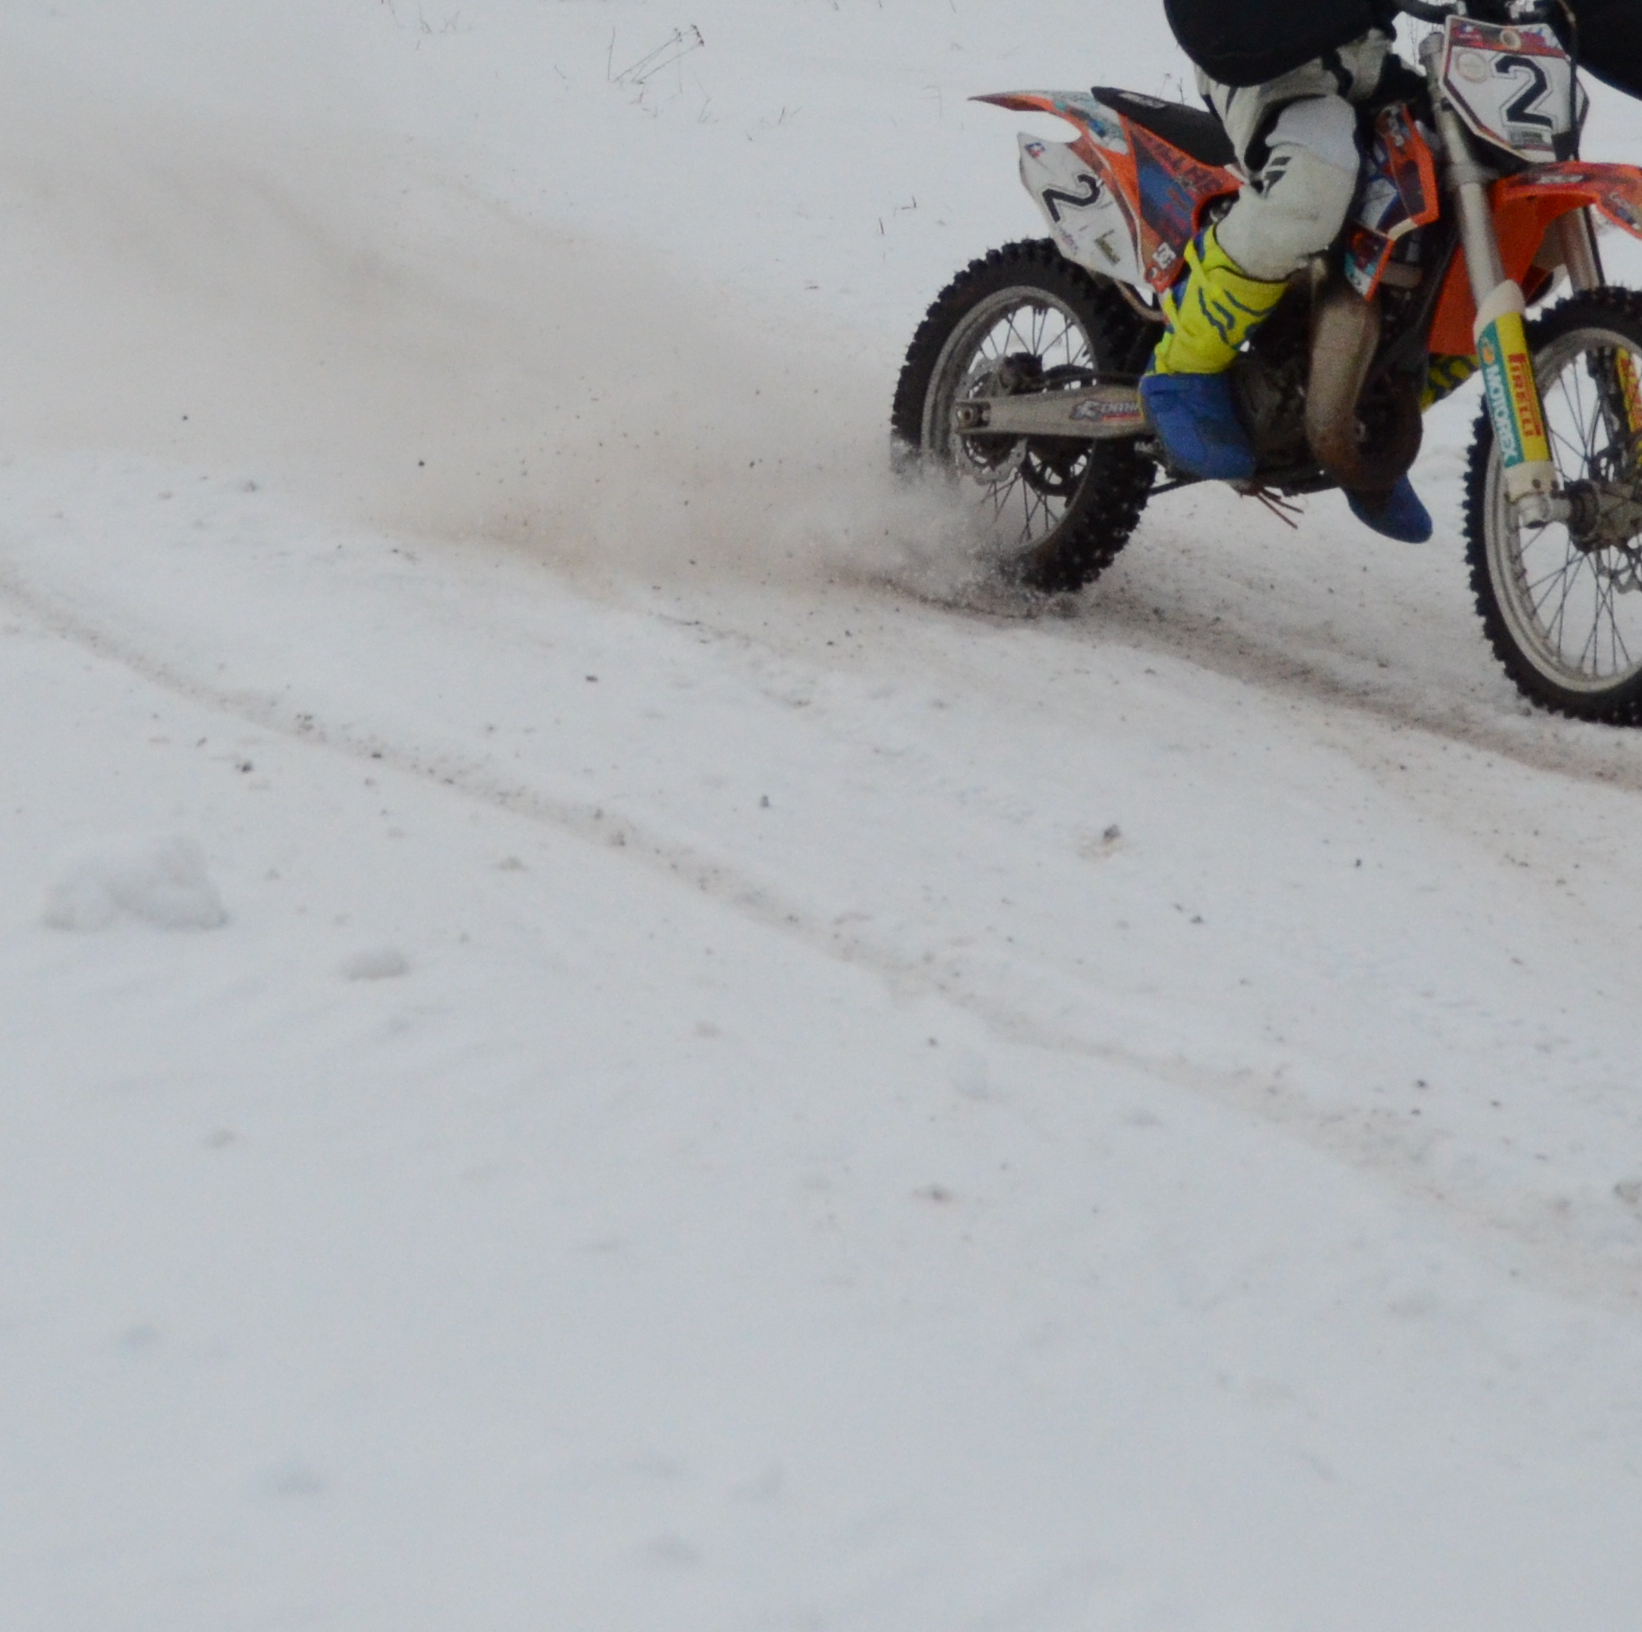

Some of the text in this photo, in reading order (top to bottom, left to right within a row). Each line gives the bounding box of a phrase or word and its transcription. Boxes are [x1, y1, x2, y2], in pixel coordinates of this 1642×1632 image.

[1495, 54, 1553, 128] 2
[1042, 173, 1100, 223] 2
[1485, 365, 1518, 462] MOTOREX
[1507, 353, 1542, 437] PIRELLI
